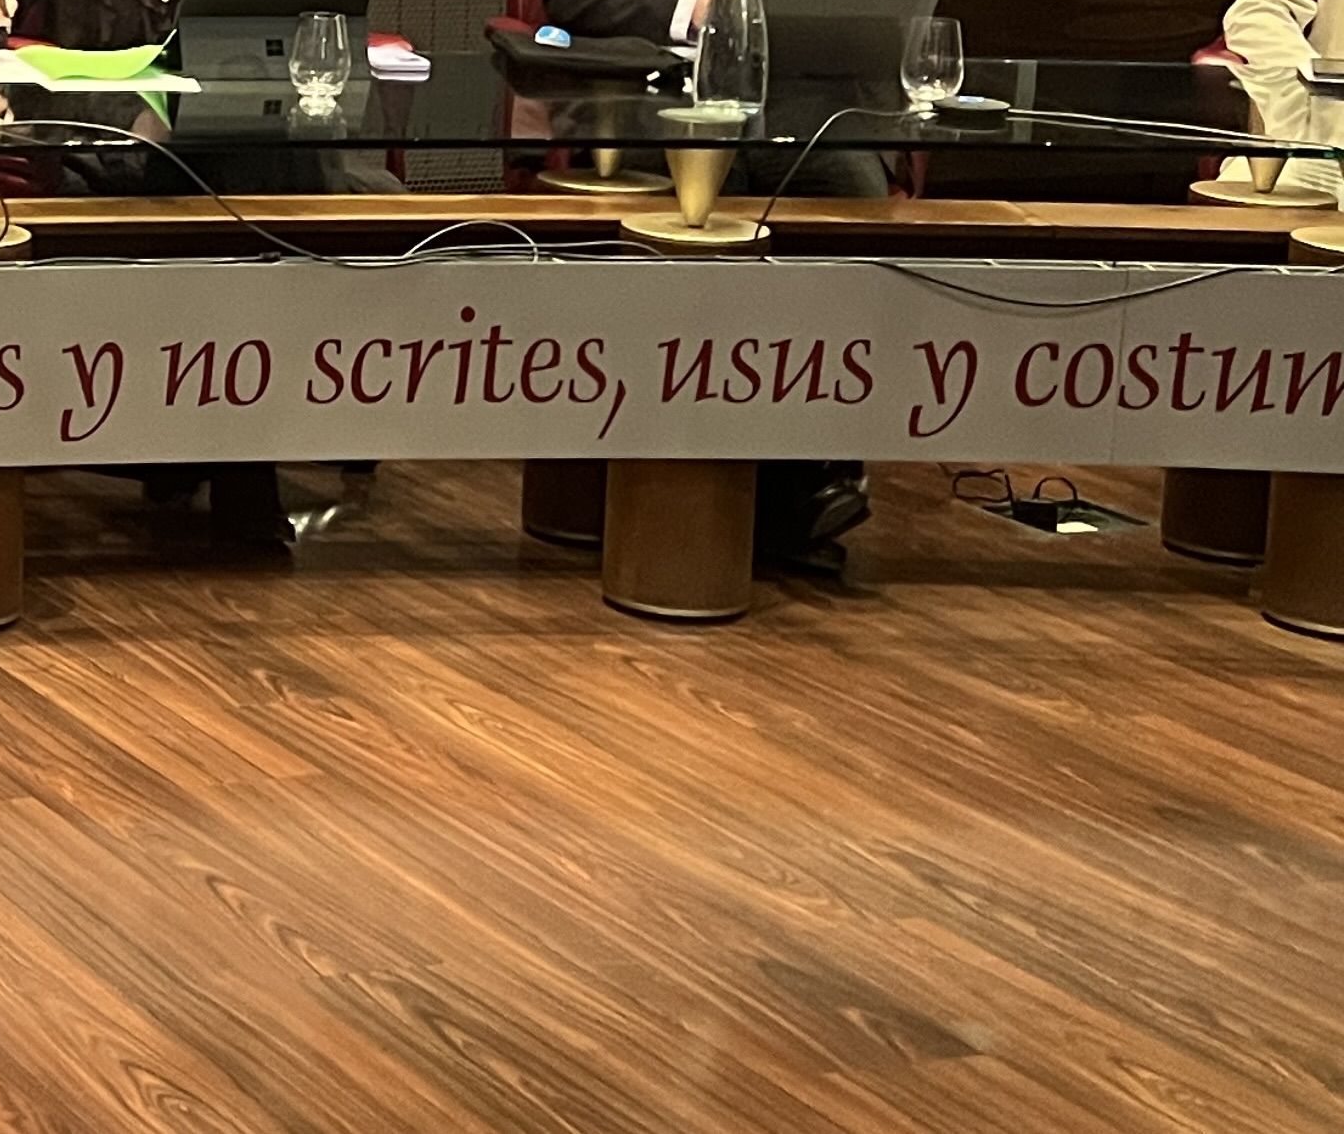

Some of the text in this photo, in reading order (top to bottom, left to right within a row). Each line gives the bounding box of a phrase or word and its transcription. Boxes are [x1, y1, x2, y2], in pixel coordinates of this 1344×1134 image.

[59, 341, 124, 443] y
[160, 338, 273, 408] no
[305, 305, 628, 441] scrites,
[657, 336, 876, 406] usus
[908, 339, 979, 438] y
